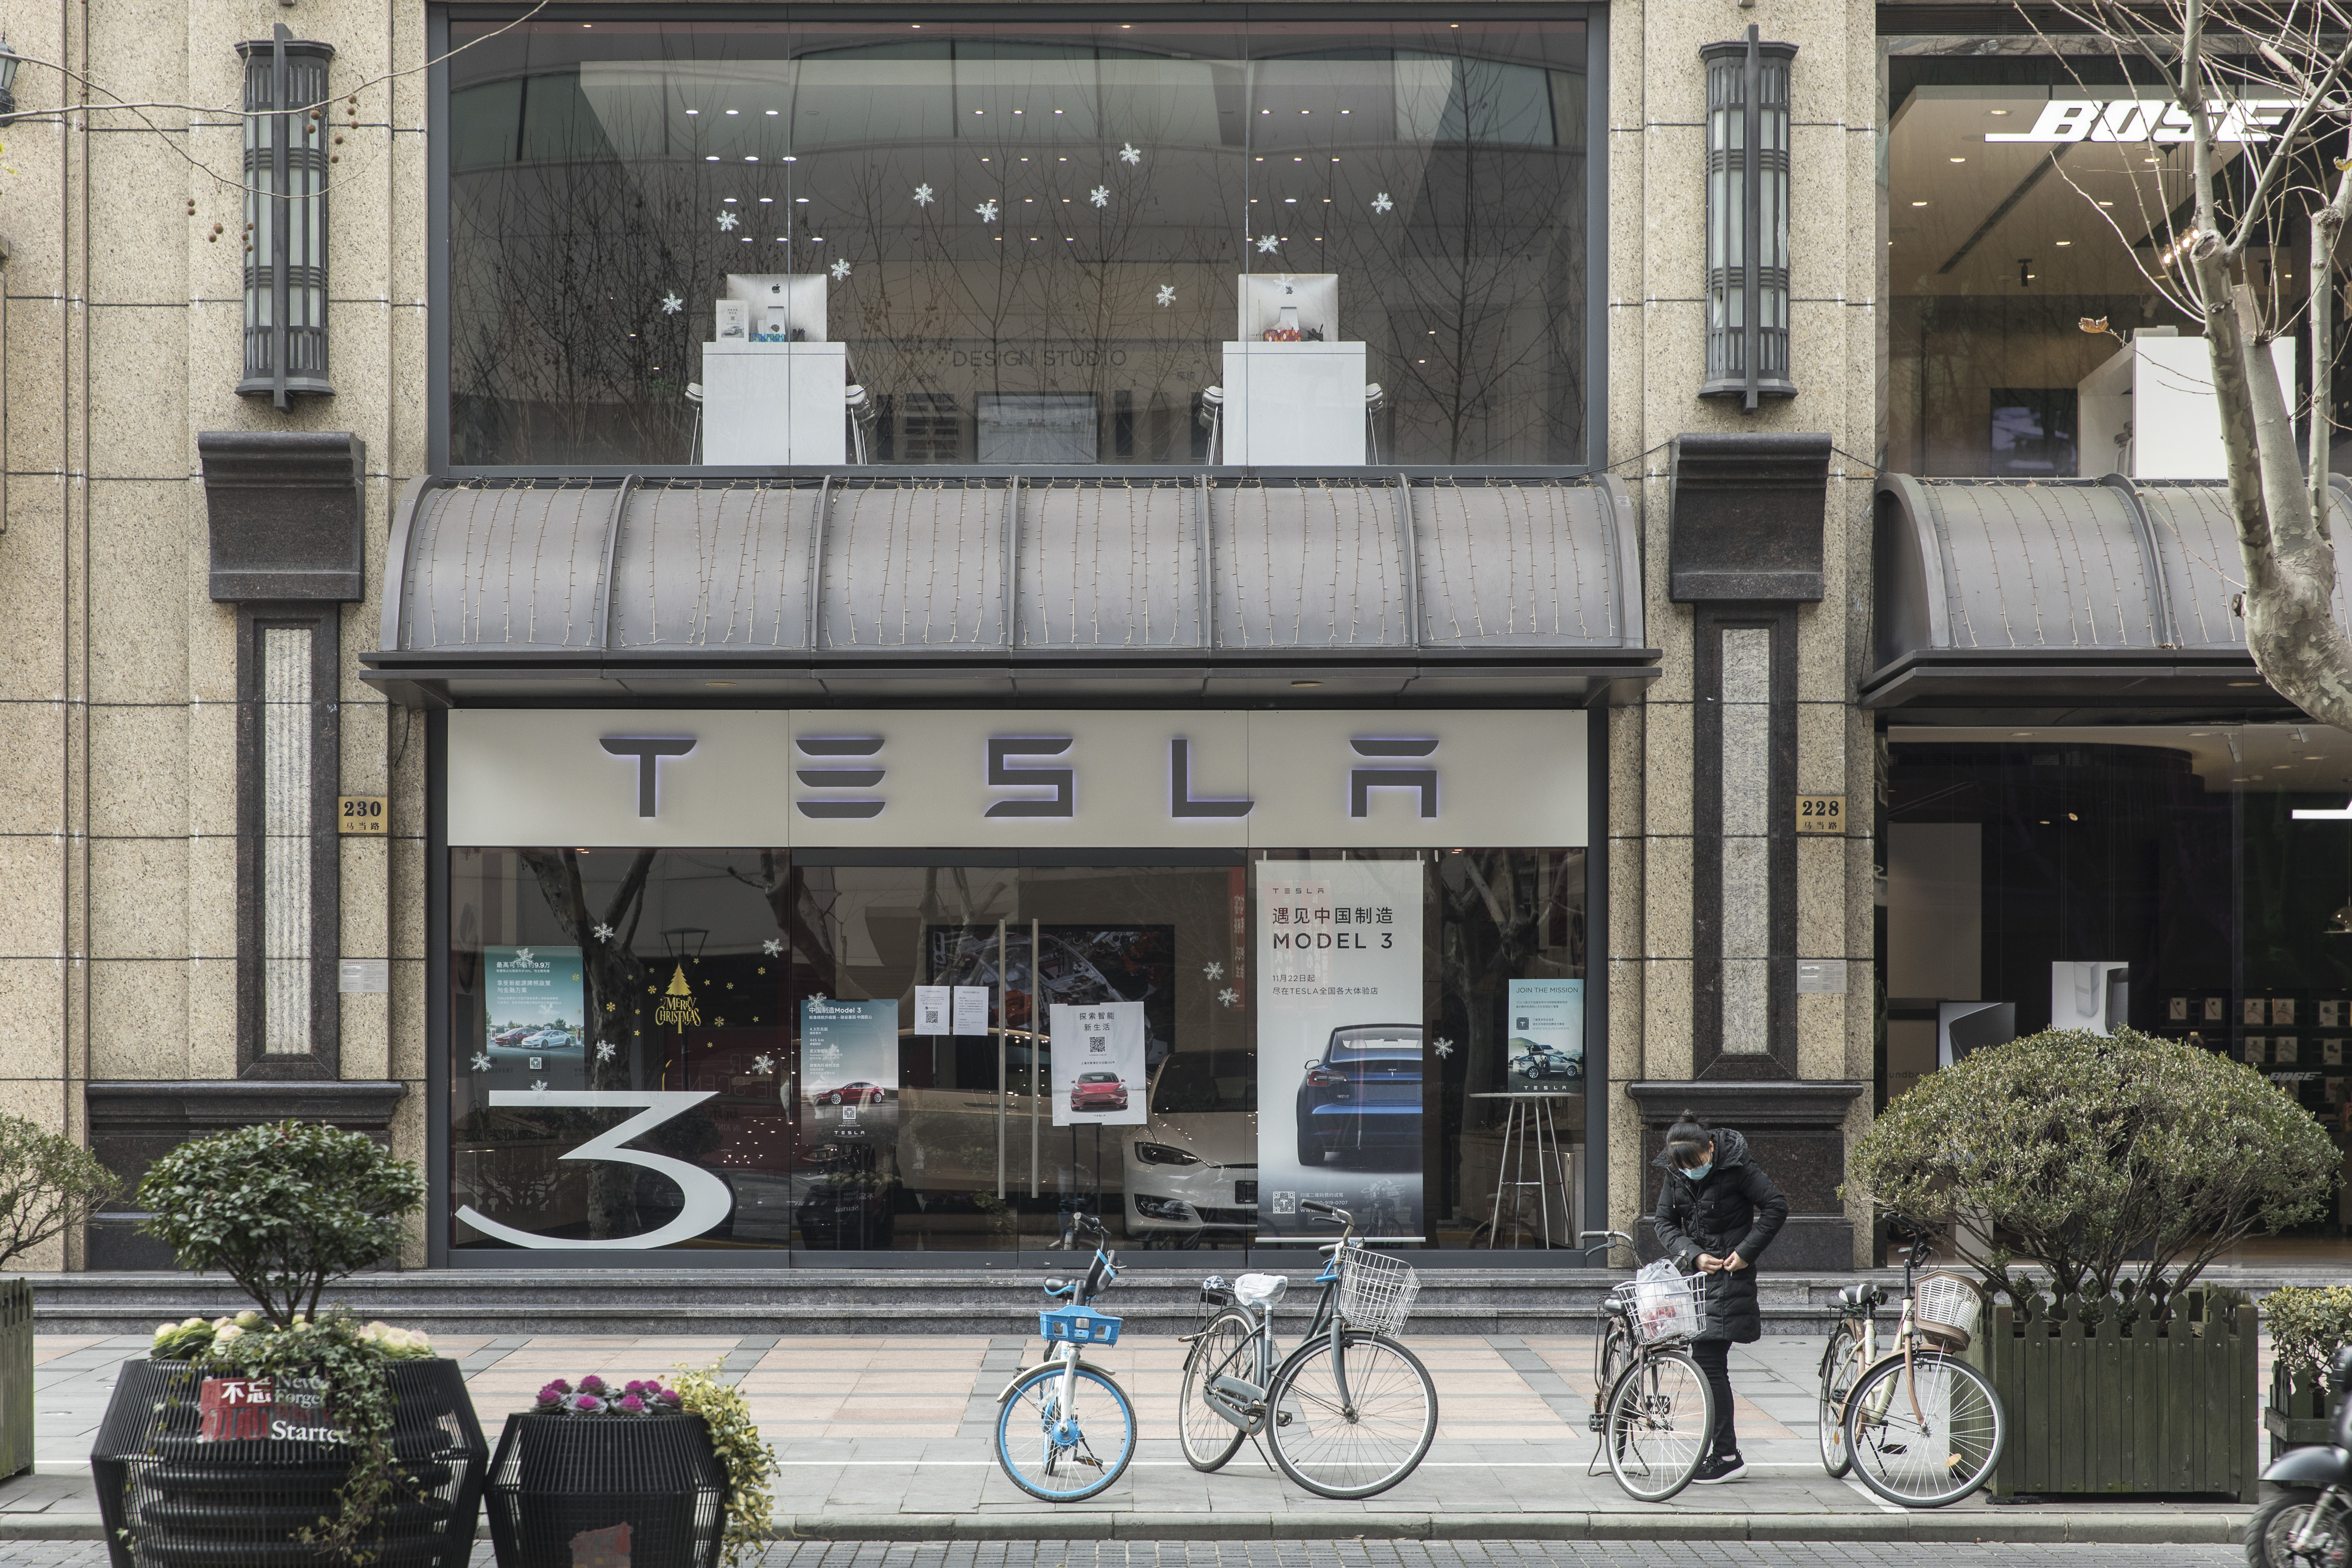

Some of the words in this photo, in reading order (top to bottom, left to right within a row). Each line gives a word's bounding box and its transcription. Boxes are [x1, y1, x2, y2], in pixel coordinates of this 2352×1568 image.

[1984, 99, 2308, 142] BOSE
[953, 350, 1034, 367] DESIGN
[1044, 350, 1127, 367] STUDIO
[599, 738, 1439, 818] TESLA
[343, 801, 382, 817] 230
[1802, 800, 1839, 817] 228
[345, 822, 380, 830] 马当路
[1803, 821, 1838, 830] 马当路
[1272, 907, 1394, 924] 遇见中国制造
[1273, 932, 1367, 949] MODEL
[1381, 932, 1393, 949] 3
[1272, 974, 1315, 982] 11月22日起
[1272, 987, 1378, 995] 尽在TESLA全国各大体验店
[660, 996, 697, 1011] MERRY
[655, 1006, 701, 1034] CHRISTMAS
[1079, 1011, 1115, 1020] 探索智能
[1084, 1023, 1110, 1031] 新生活
[2270, 1071, 2322, 1081] BOSE
[455, 1091, 732, 1249] 3
[220, 1380, 272, 1405] 不忘
